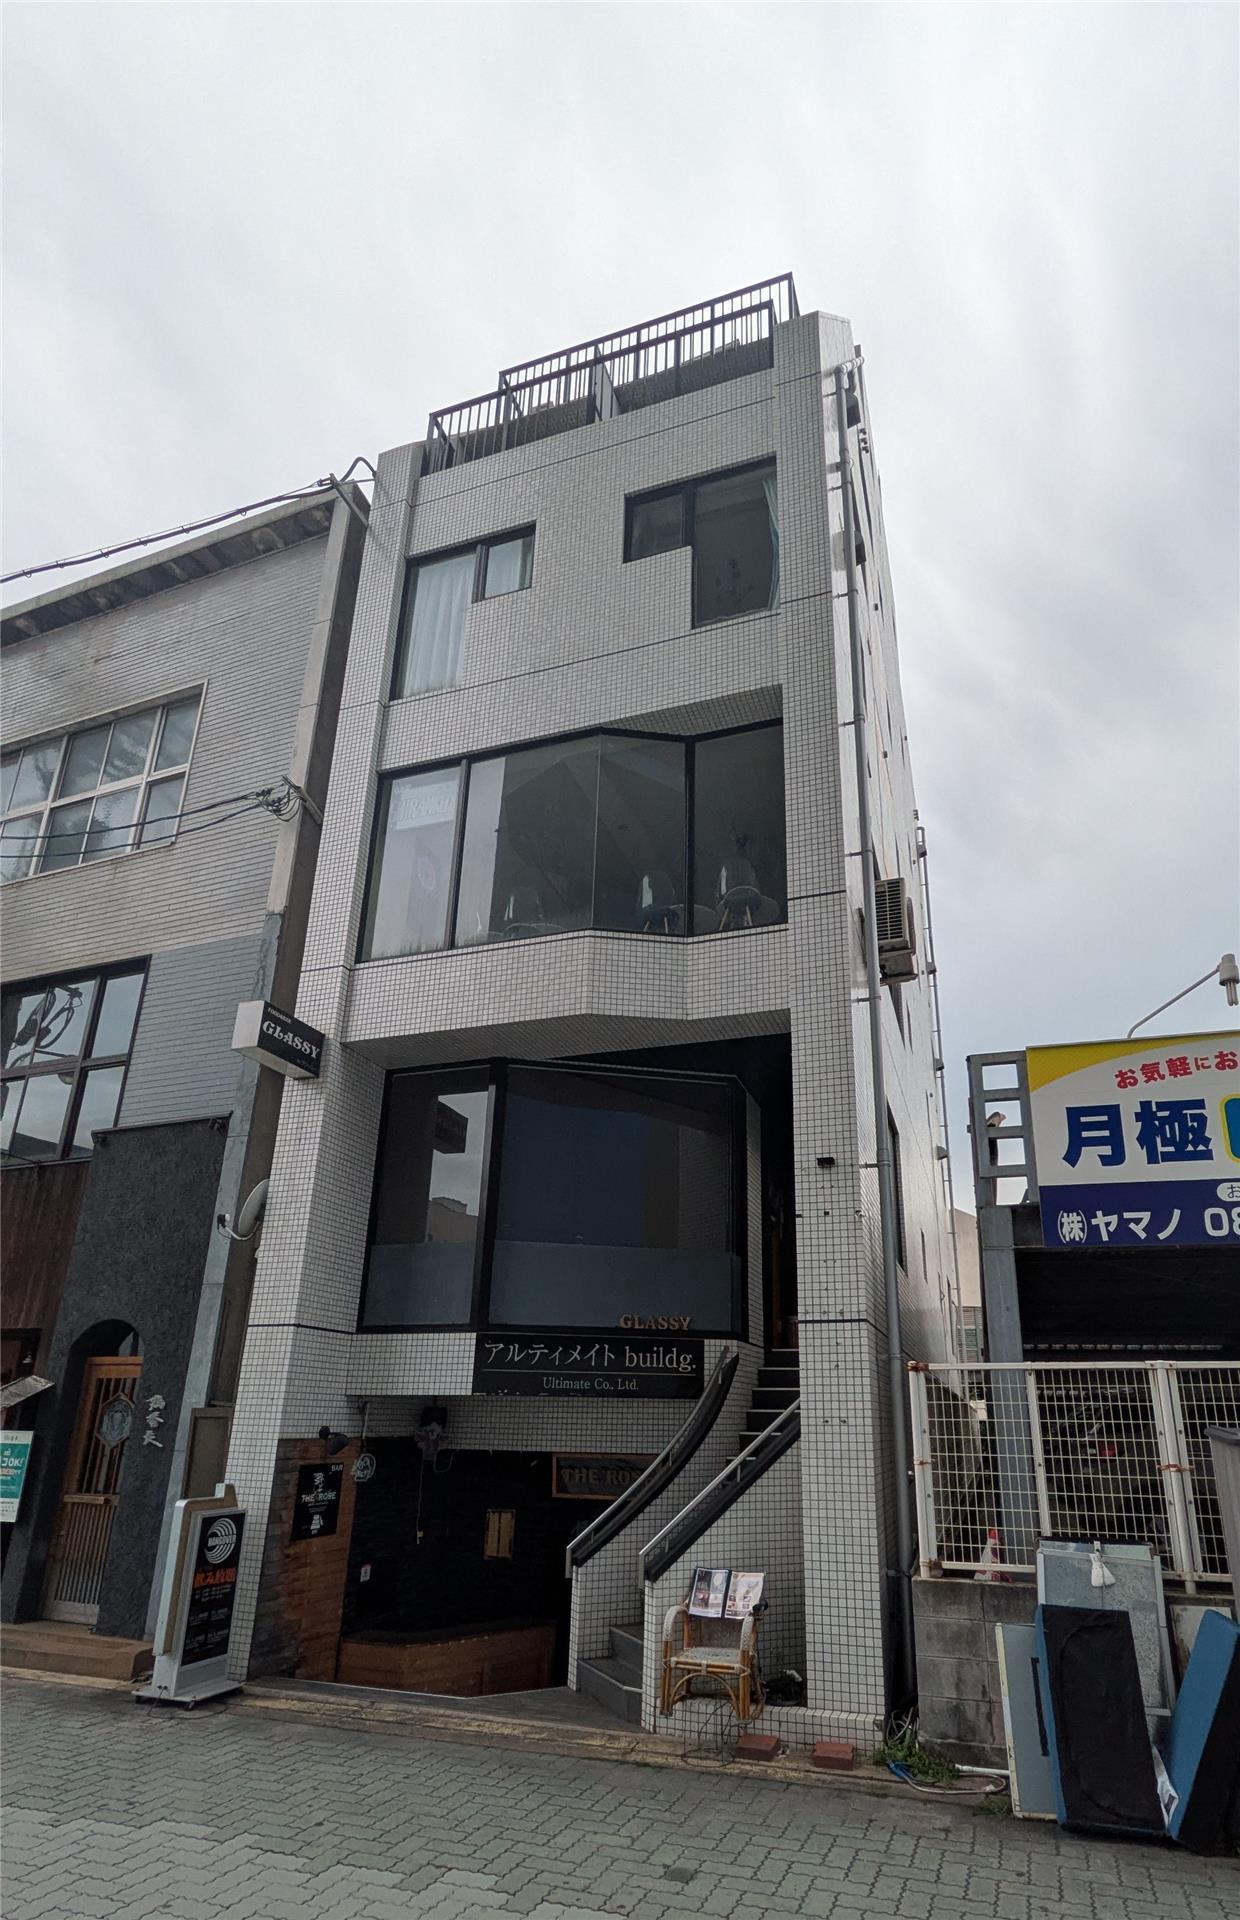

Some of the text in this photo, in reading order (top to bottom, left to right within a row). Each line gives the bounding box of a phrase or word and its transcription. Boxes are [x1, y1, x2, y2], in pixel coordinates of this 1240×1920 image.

[262, 1020, 320, 1059] GLASSY
[1062, 1098, 1214, 1169] 月極
[619, 1314, 692, 1331] GLASSY
[484, 1343, 697, 1372] アルティメイト buildg.
[543, 1376, 591, 1390] Ultimate
[618, 1379, 639, 1391] Ltd.
[561, 1468, 599, 1485] THE
